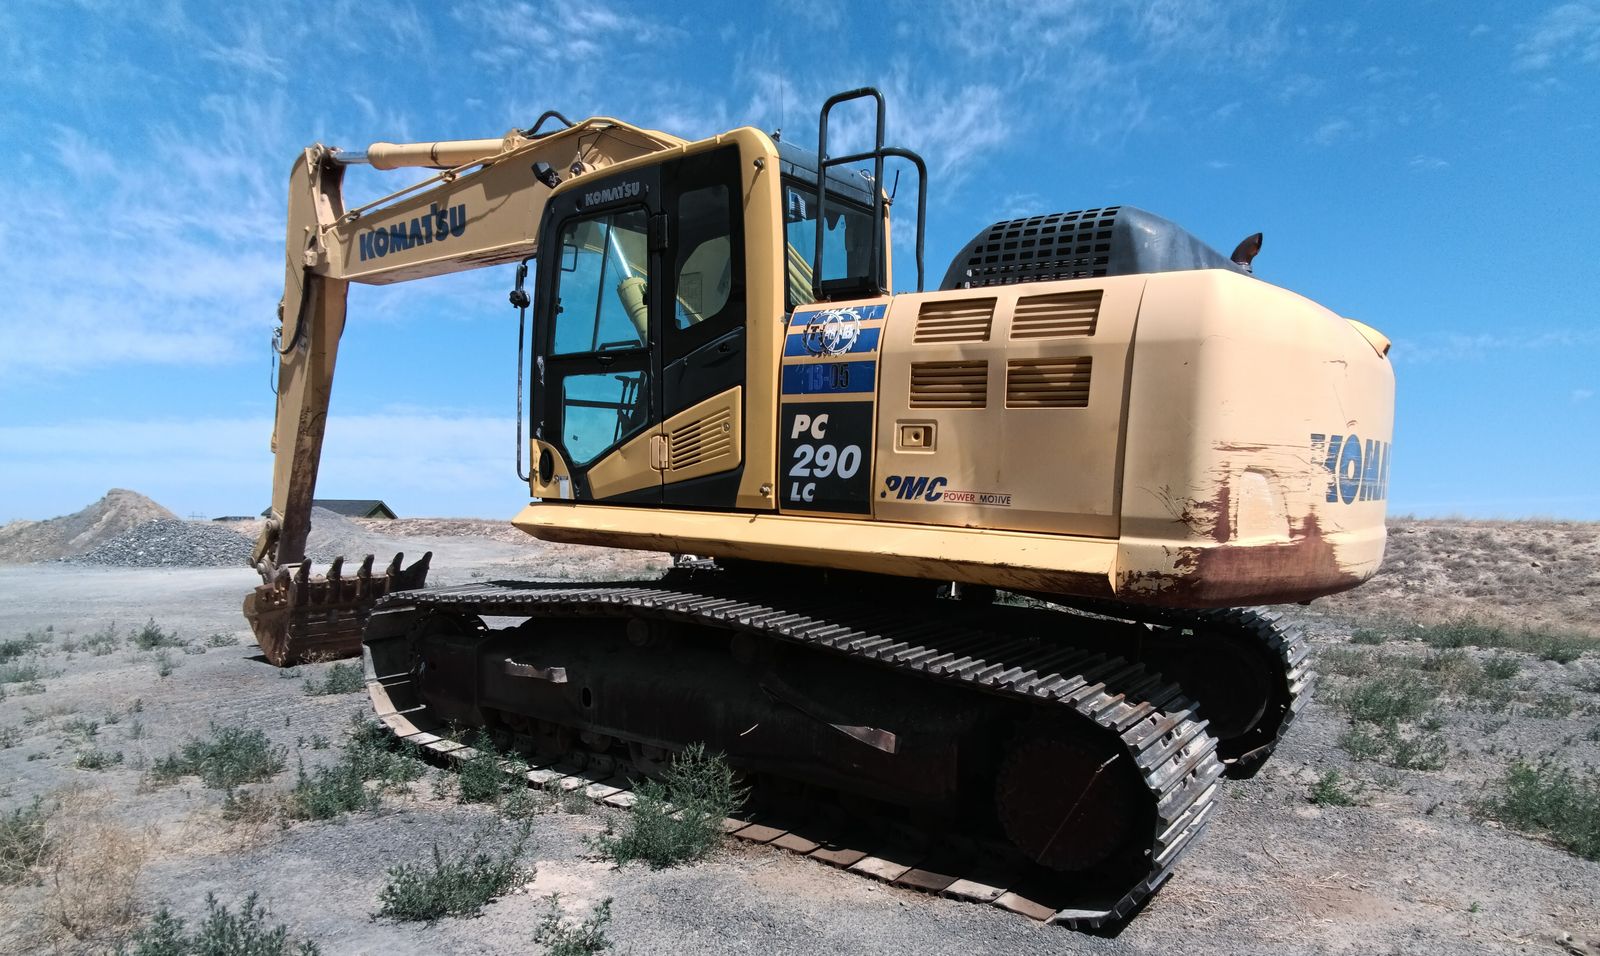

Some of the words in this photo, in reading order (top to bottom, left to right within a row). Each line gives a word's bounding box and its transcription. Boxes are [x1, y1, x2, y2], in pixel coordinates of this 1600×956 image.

[585, 182, 640, 206] KOMATSU
[359, 203, 466, 262] KOMATSU
[791, 413, 829, 440] PC
[788, 443, 862, 479] 290
[790, 482, 816, 502] LC
[880, 475, 948, 502] PMC
[943, 492, 975, 502] POWER
